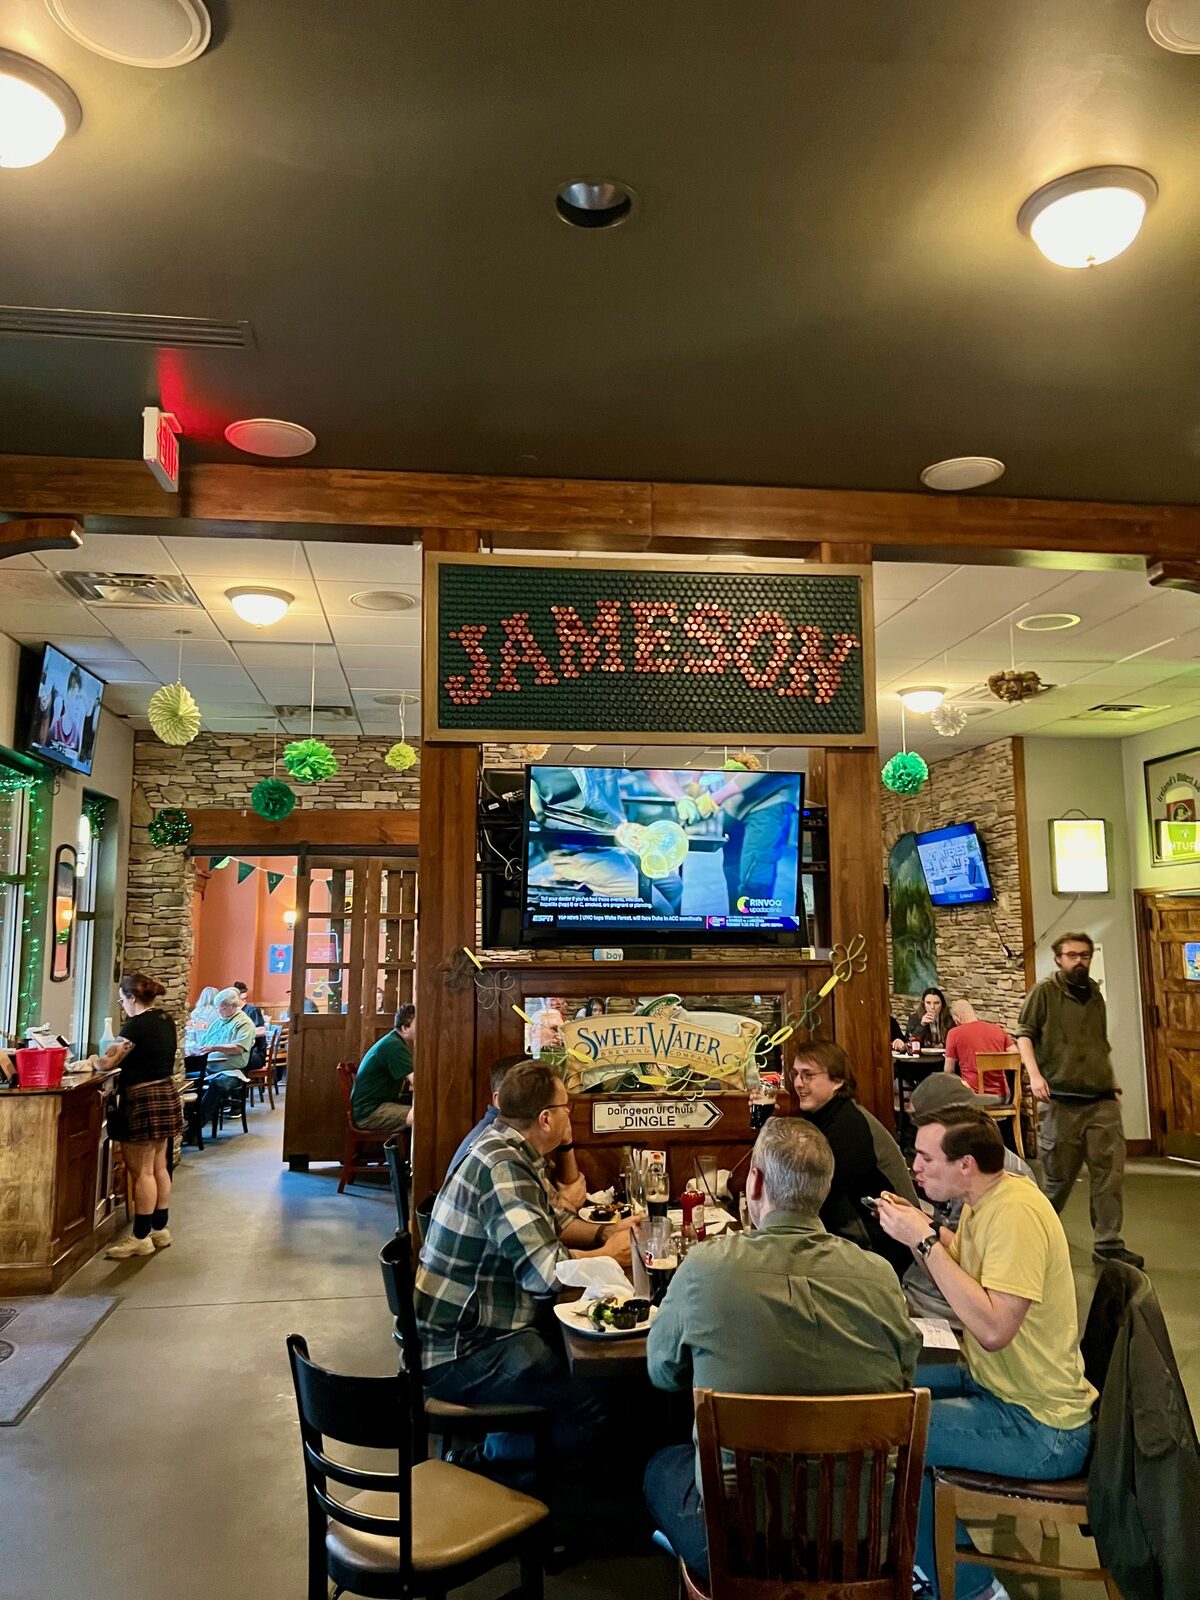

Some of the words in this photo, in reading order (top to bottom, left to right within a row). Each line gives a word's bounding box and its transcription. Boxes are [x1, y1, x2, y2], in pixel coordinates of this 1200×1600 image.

[444, 600, 861, 704] JAMESON
[600, 1048, 650, 1058] BREWING
[669, 1050, 716, 1064] COMPANY
[624, 1116, 676, 1127] DINGLE
